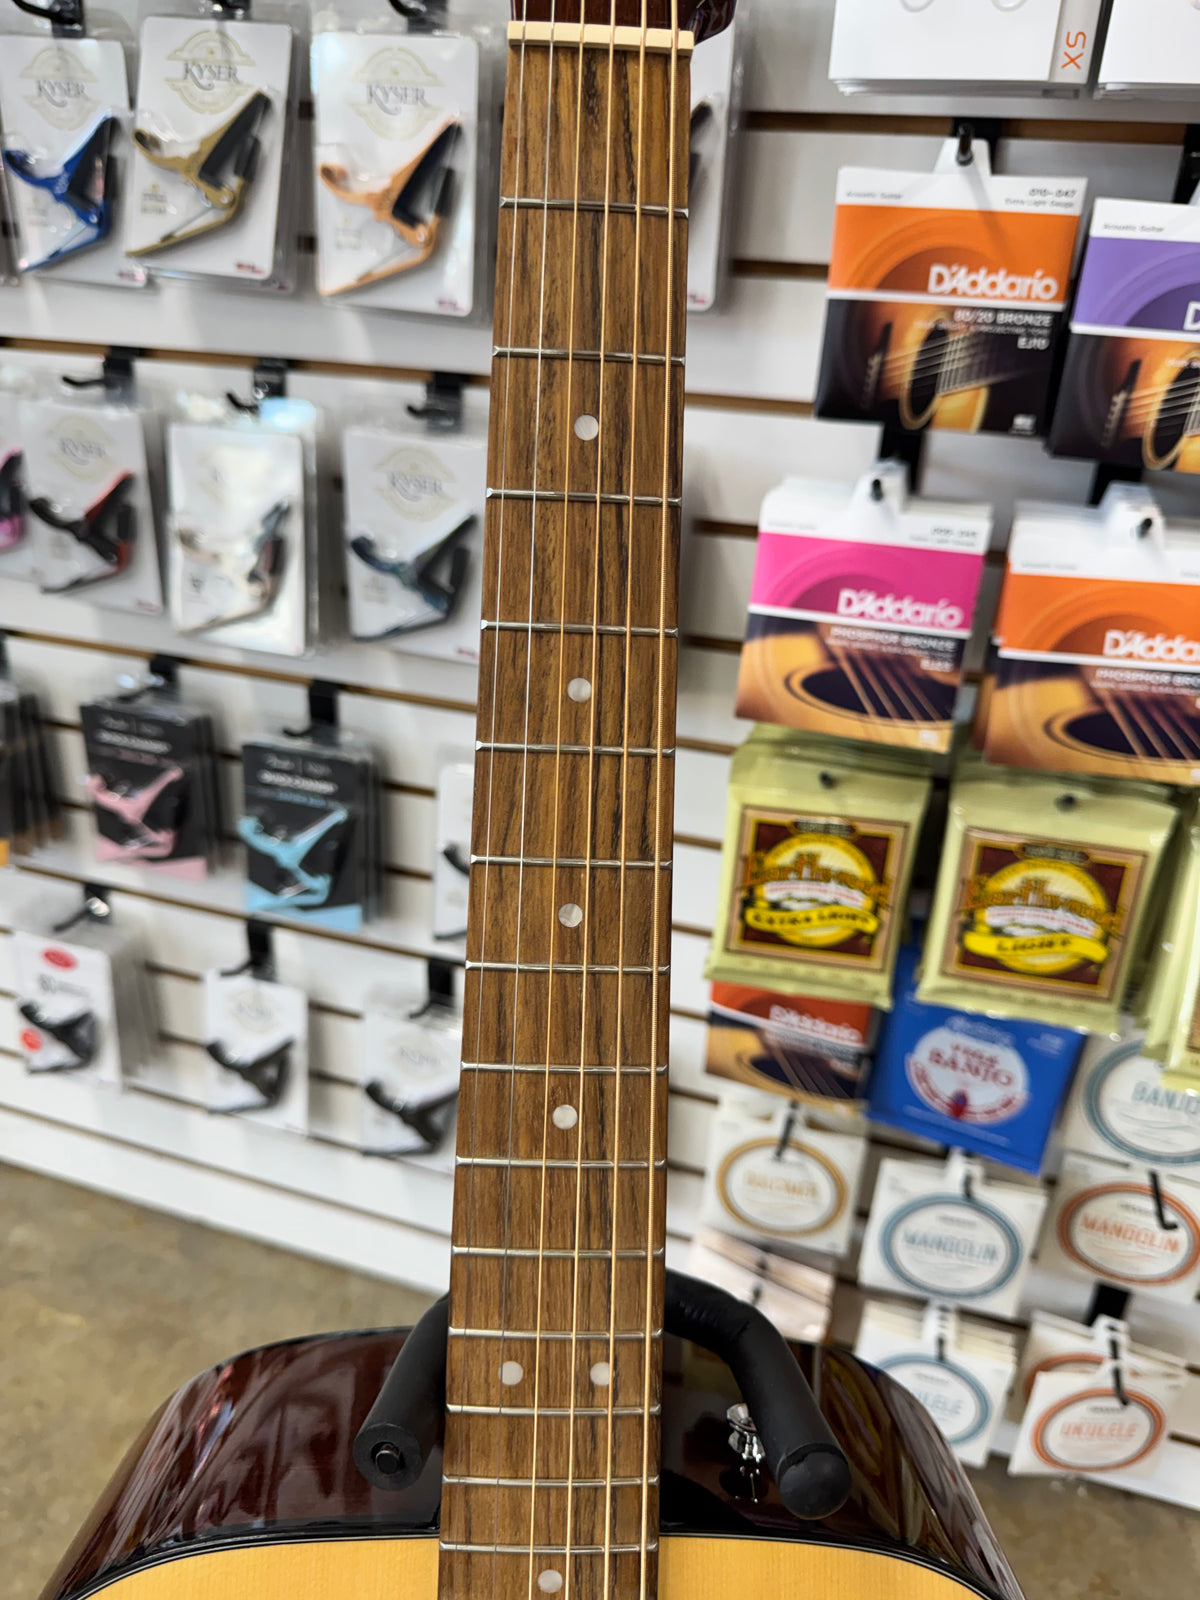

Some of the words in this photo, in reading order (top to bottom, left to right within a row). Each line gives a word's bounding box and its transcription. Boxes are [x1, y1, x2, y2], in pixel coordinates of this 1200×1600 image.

[1061, 31, 1087, 70] XS
[183, 62, 240, 90] KYSER
[36, 79, 86, 107] KYSER
[366, 83, 429, 116] KYSER
[996, 311, 1053, 327] BRONZE
[1080, 1212, 1180, 1255] MANDOLIN
[1060, 1422, 1140, 1440] UKULELE
